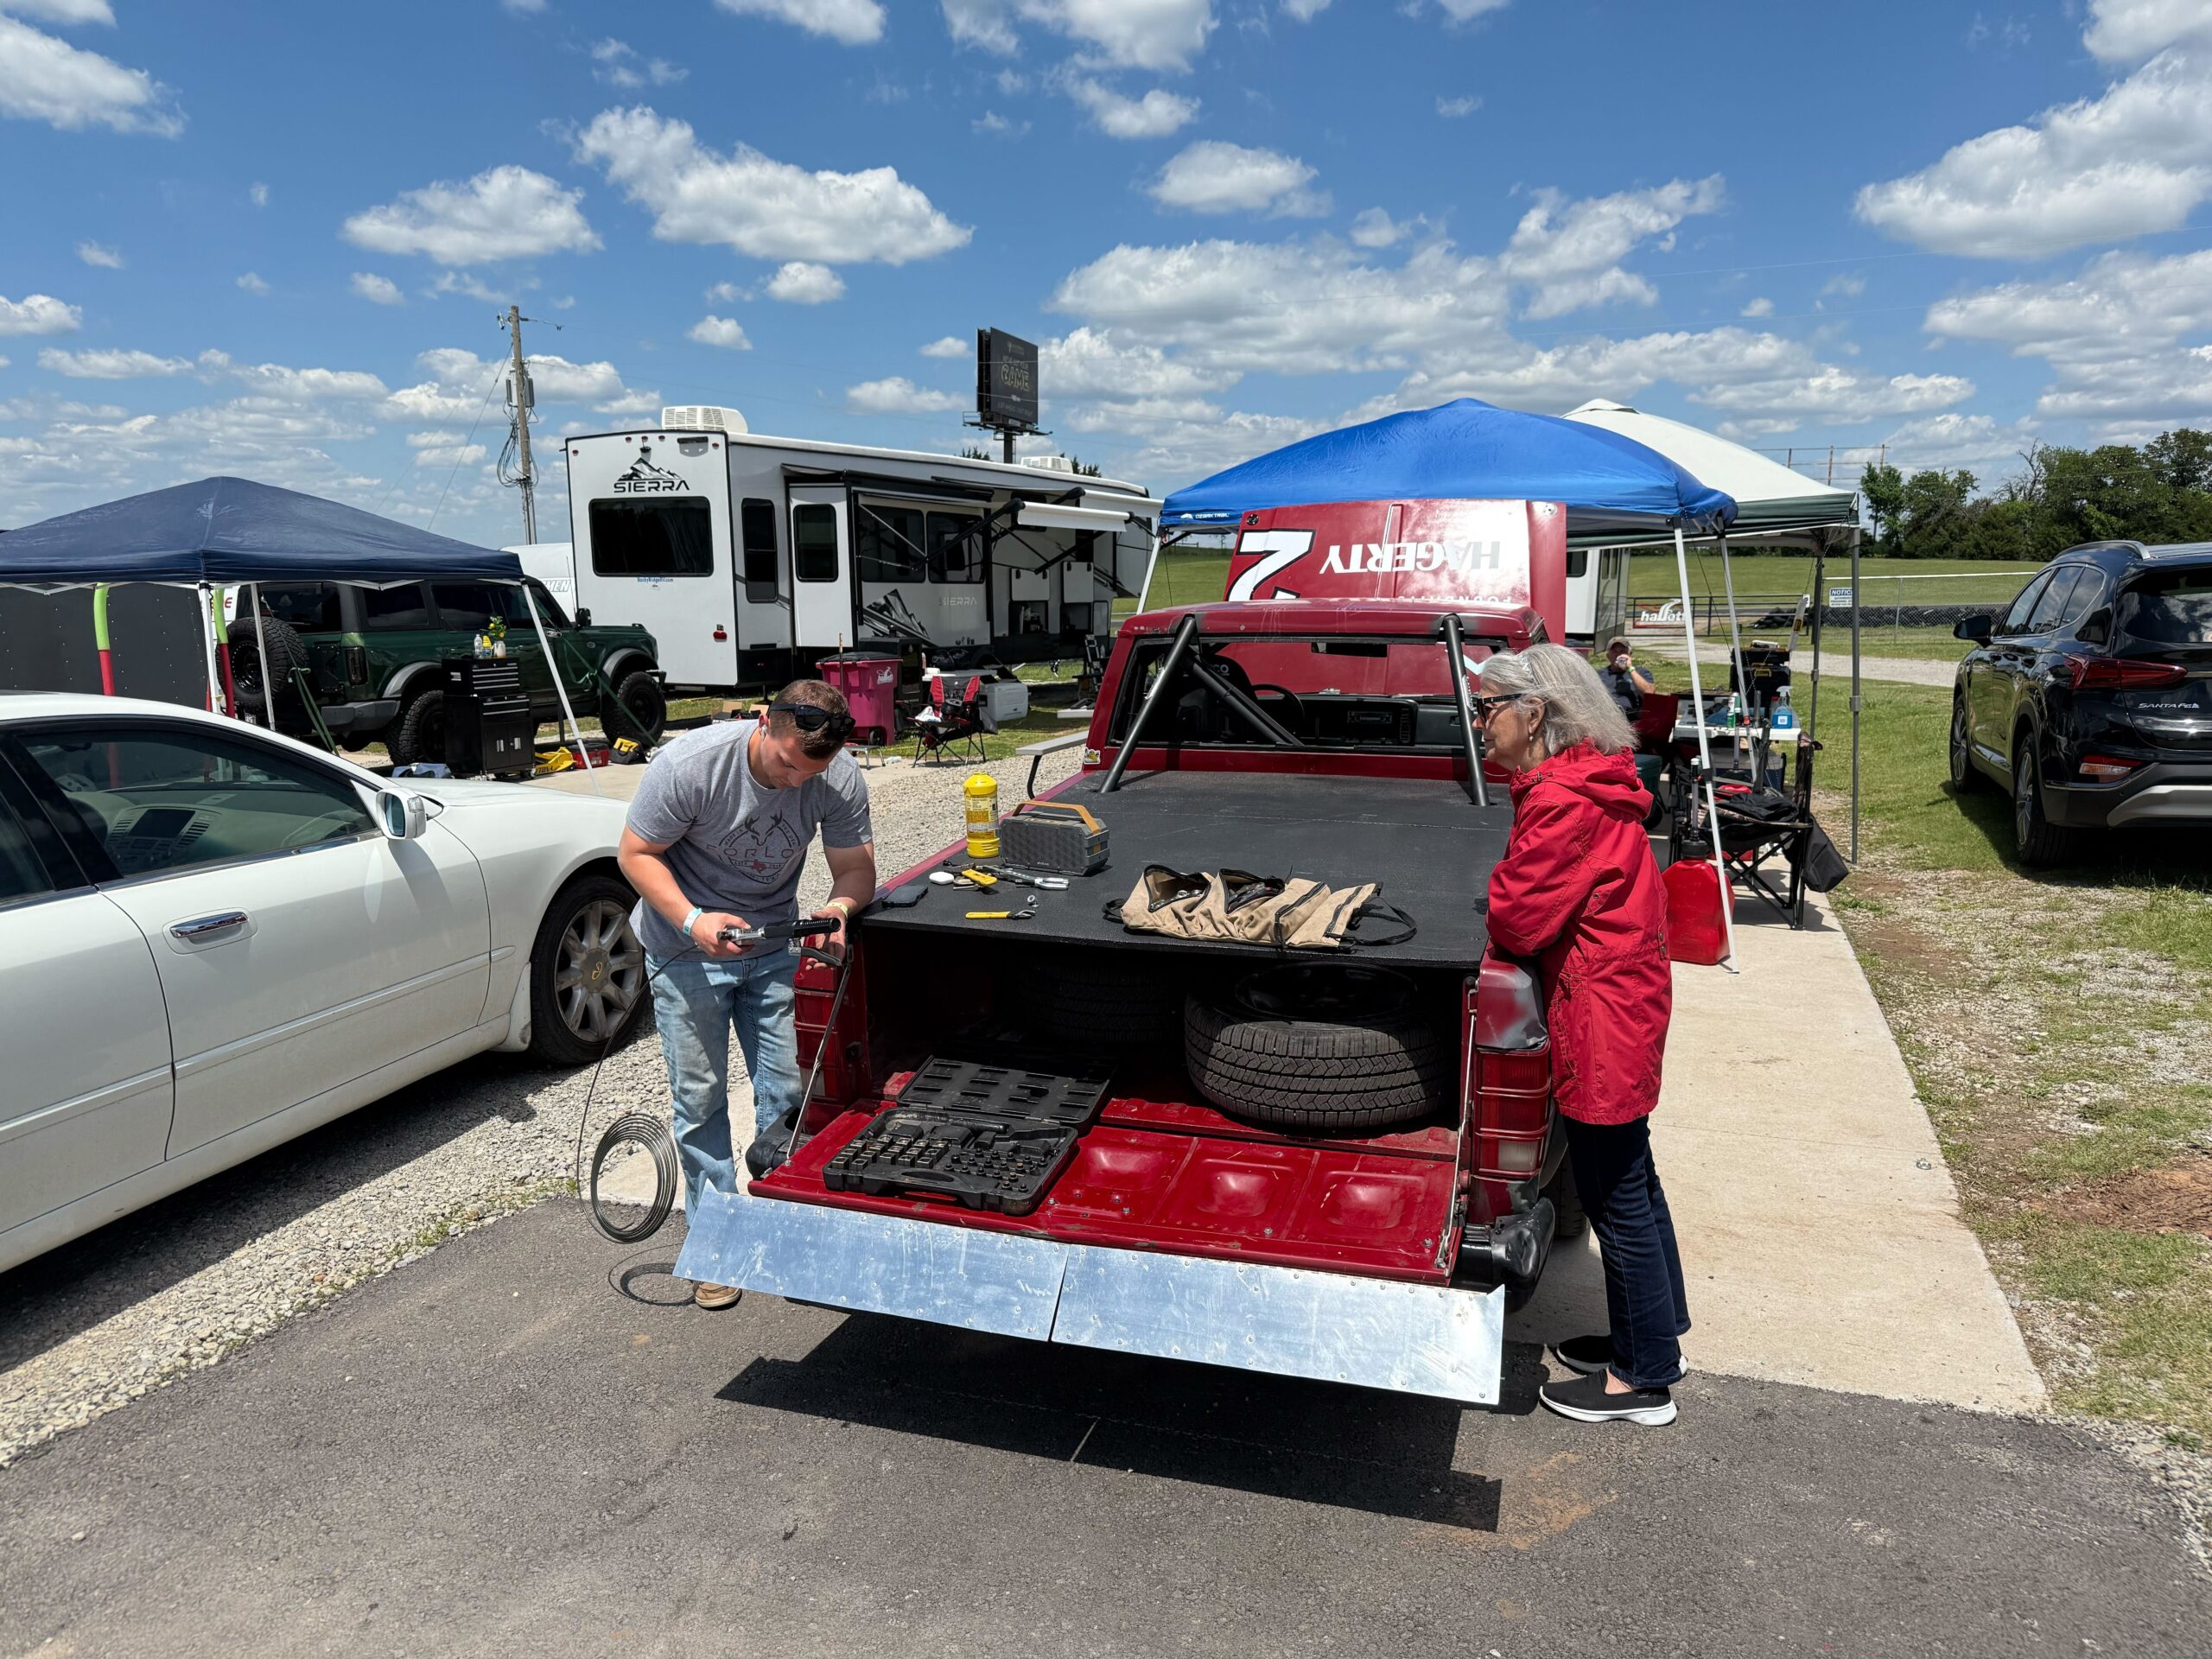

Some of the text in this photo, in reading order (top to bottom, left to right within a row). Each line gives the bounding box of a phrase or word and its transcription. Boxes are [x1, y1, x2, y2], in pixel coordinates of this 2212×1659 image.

[613, 480, 690, 493] SIERRA
[1319, 541, 1501, 575] HAGERTY
[938, 596, 977, 606] SIERRA
